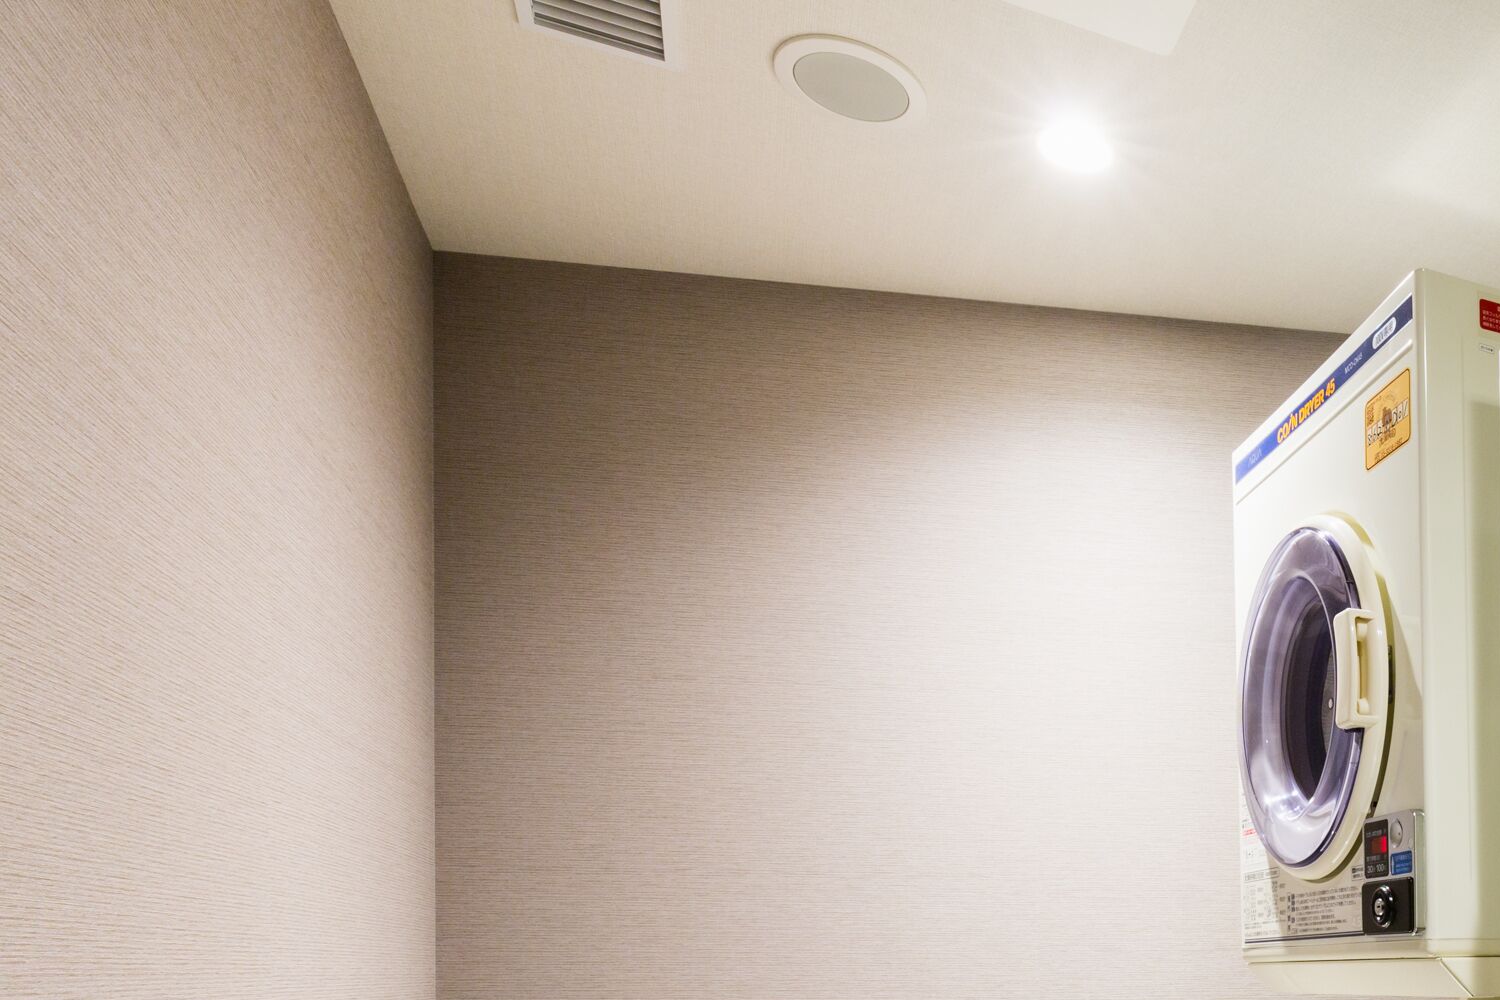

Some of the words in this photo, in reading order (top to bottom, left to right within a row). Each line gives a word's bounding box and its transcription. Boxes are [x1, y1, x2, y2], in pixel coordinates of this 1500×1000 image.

[1276, 410, 1299, 444] COIN
[1298, 388, 1325, 424] DRYER
[1324, 378, 1336, 398] 45
